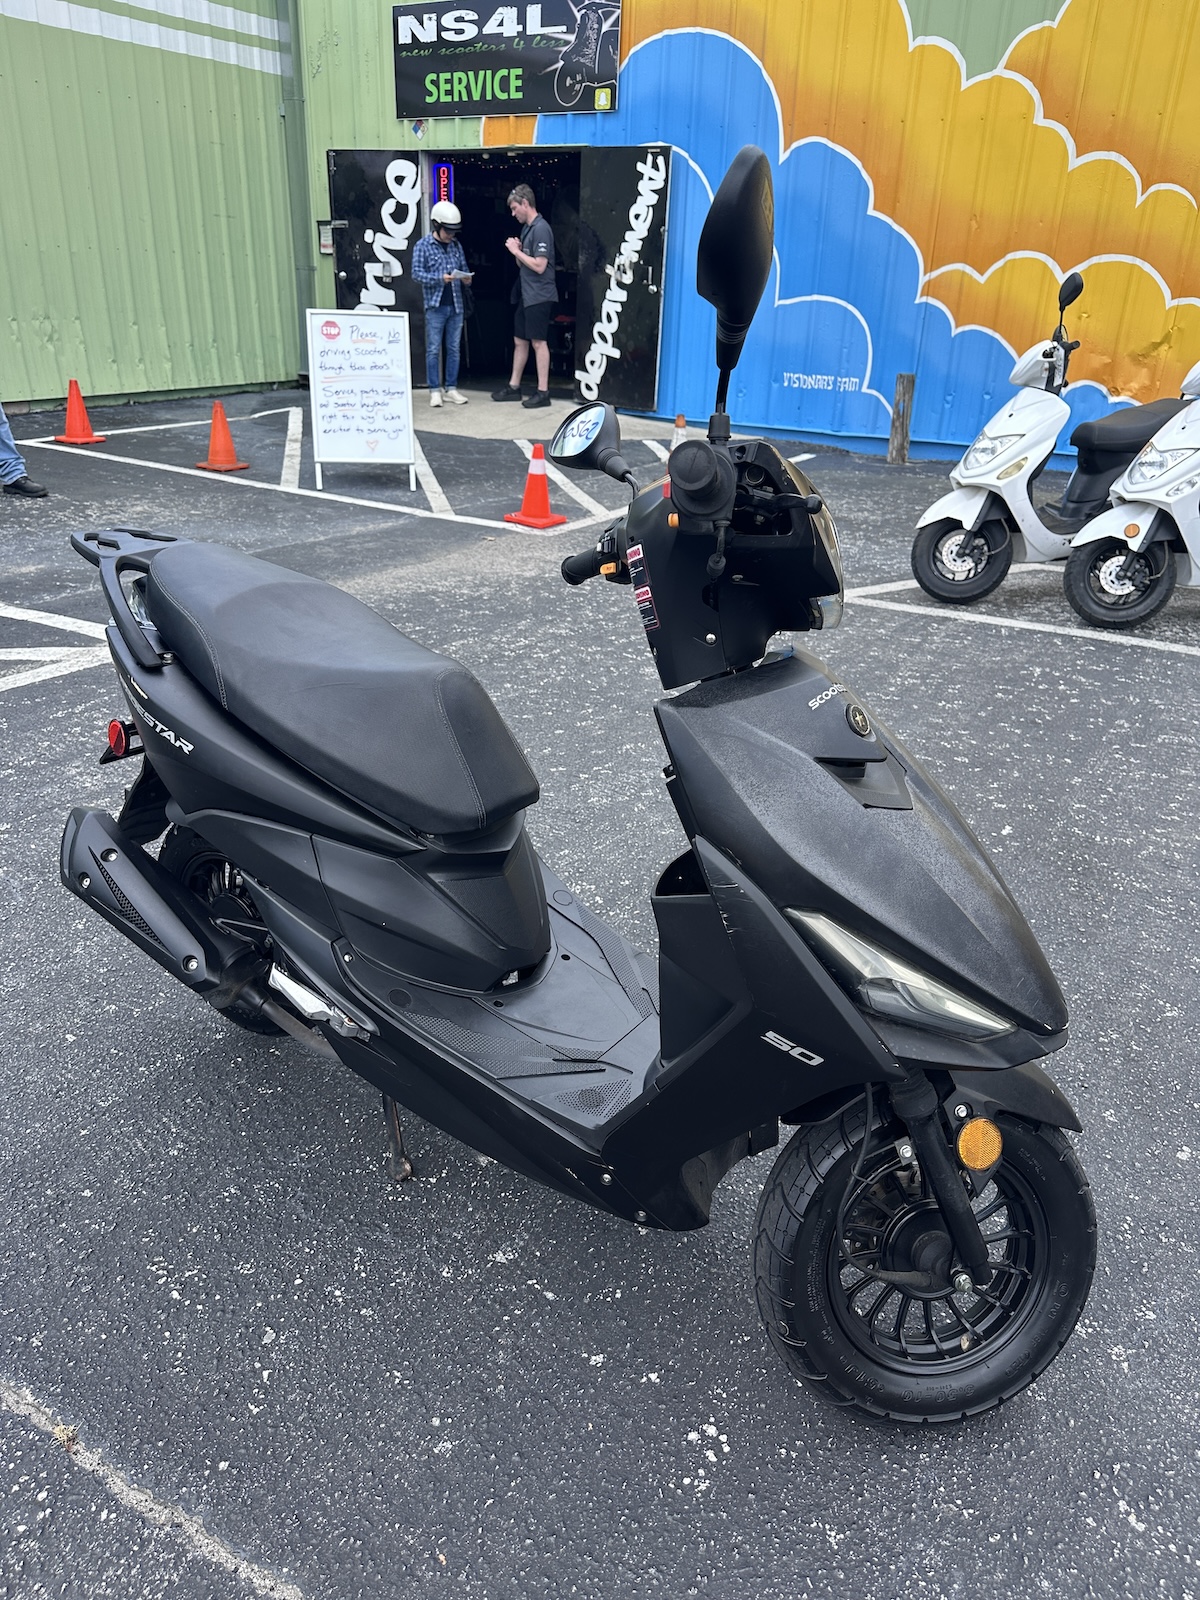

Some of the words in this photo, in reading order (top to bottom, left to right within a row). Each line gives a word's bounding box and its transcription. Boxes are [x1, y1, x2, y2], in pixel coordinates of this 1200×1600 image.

[398, 4, 567, 45] NS4L
[400, 47, 433, 58] new
[437, 41, 506, 56] scooters
[512, 37, 526, 49] 4
[531, 34, 567, 48] less
[424, 68, 523, 103] SERVICE
[439, 166, 449, 202] OPE
[353, 158, 422, 311] rvice
[574, 152, 667, 401] department
[321, 326, 340, 336] STOP
[783, 372, 835, 391] VISIONARY
[760, 1030, 825, 1067] 50
